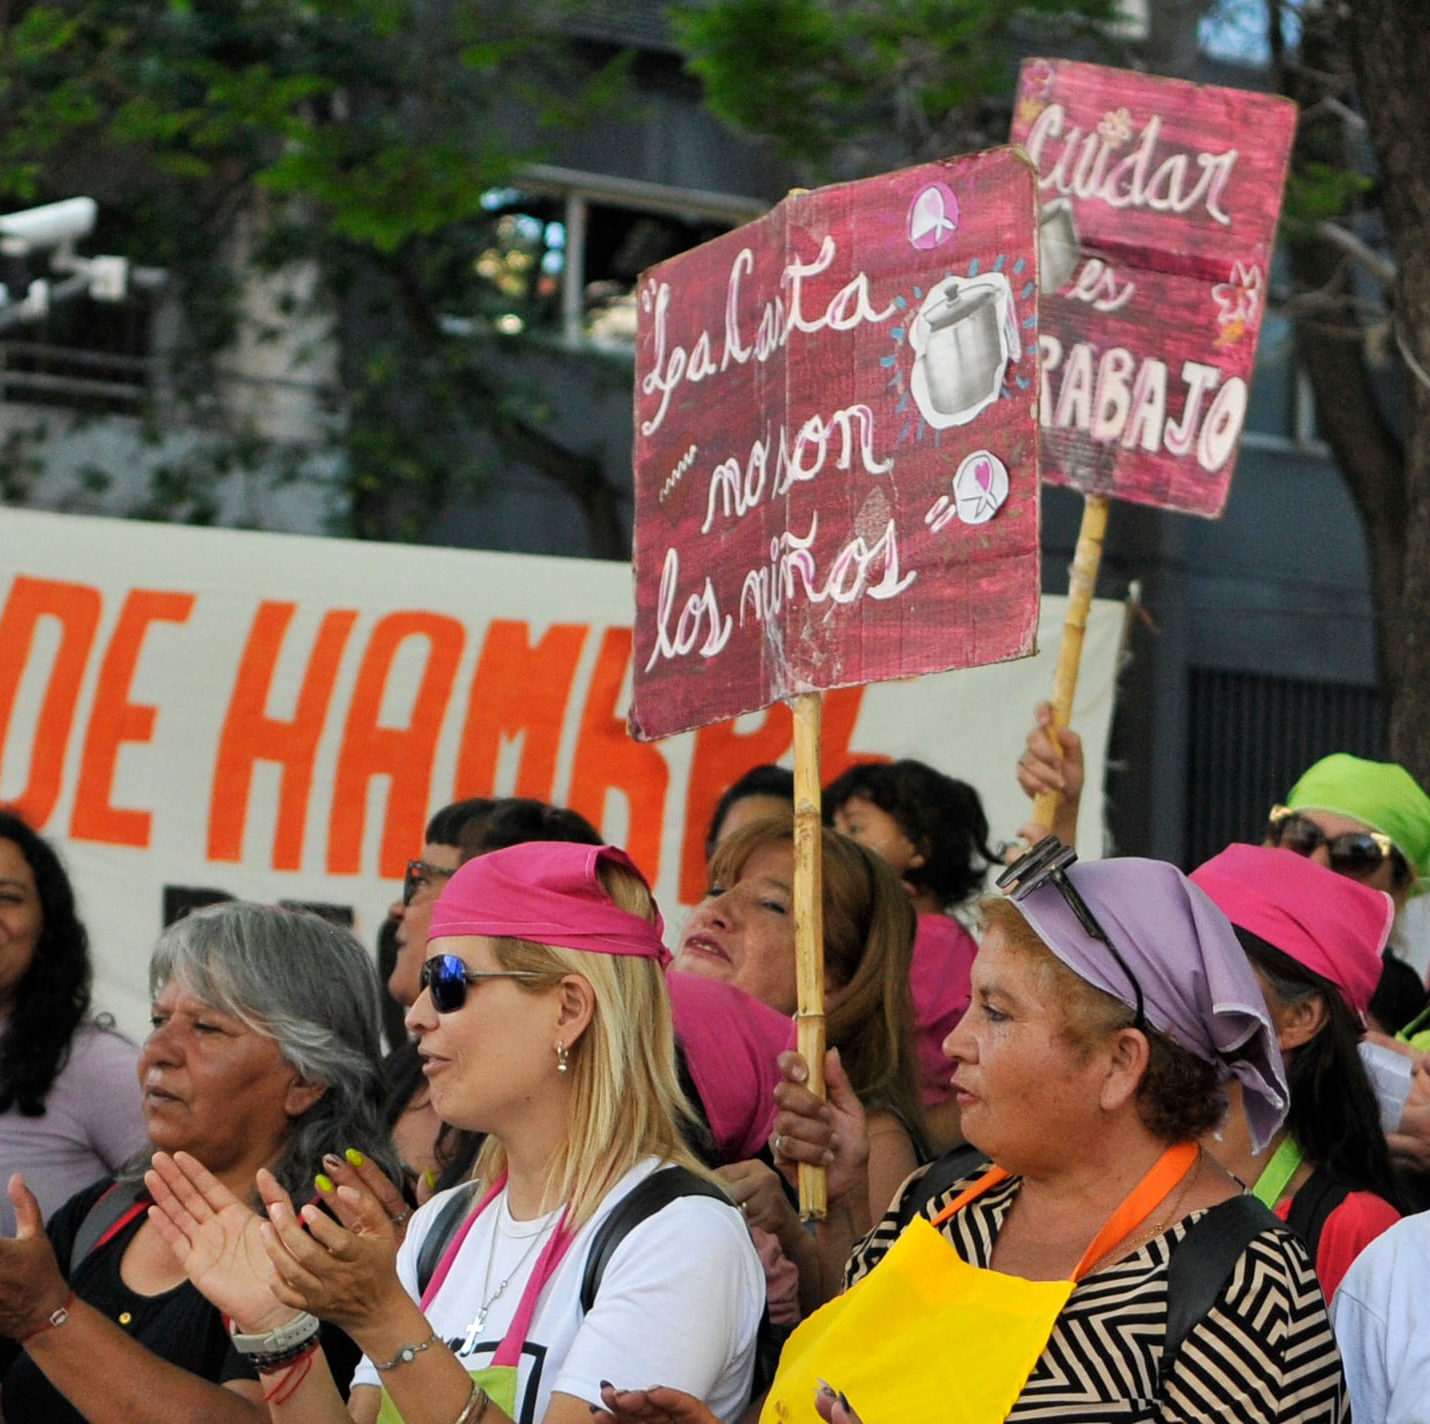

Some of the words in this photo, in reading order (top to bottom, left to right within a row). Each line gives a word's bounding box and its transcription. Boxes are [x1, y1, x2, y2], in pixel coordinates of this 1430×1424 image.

[1025, 104, 1239, 226] Cuidar
[1066, 258, 1135, 312] es
[1038, 334, 1248, 473] RABAJO
[644, 547, 734, 674] los
[738, 510, 918, 628] niños
